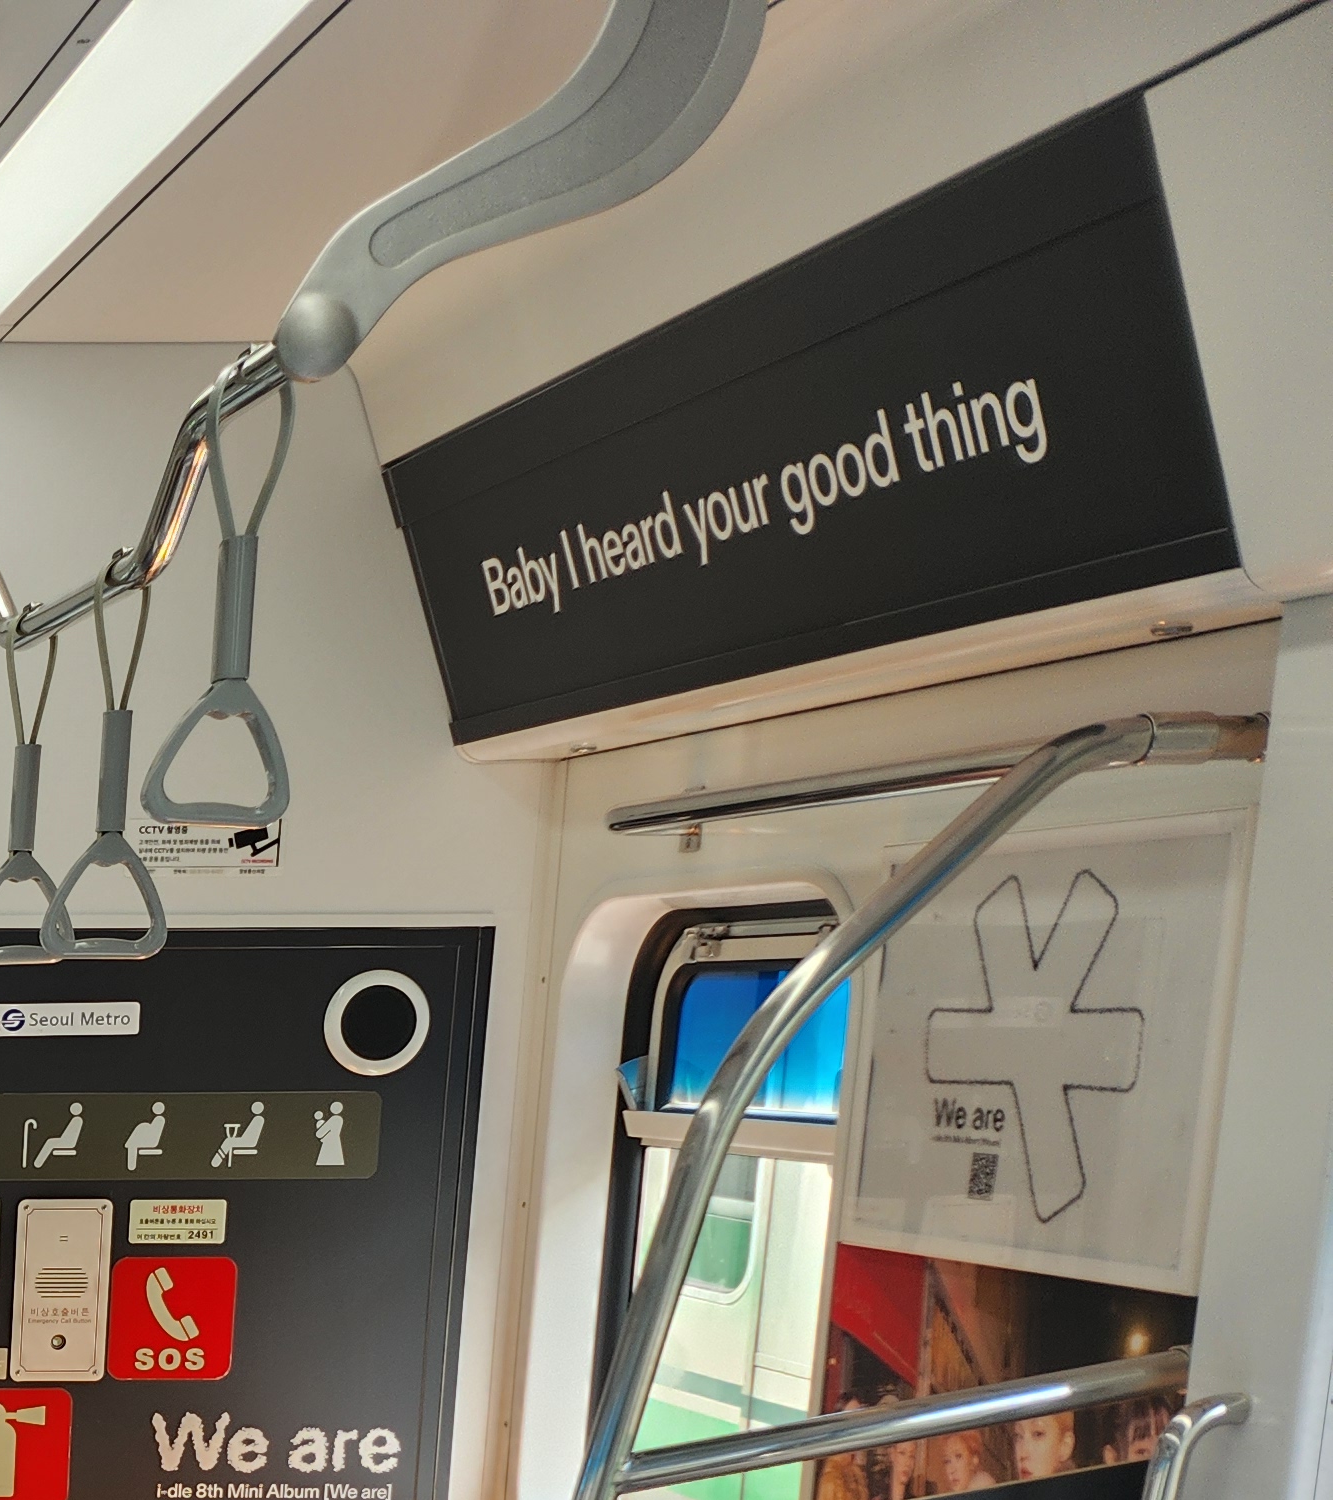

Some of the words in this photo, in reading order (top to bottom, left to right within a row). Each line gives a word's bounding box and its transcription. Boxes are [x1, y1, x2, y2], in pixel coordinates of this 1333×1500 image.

[482, 547, 559, 615] Baby
[561, 530, 579, 588] I
[578, 491, 682, 583] heard
[683, 475, 768, 565] your
[781, 409, 899, 534] good
[904, 379, 1047, 472] thing
[138, 825, 164, 834] CCTV
[28, 1012, 74, 1027] Seoul
[80, 1011, 131, 1026] Metro
[934, 1097, 967, 1130] We
[973, 1107, 1006, 1132] are
[152, 1204, 204, 1215] 비상통화장치
[187, 1230, 214, 1240] 2491
[30, 1307, 90, 1317] 비상호출버튼
[134, 1348, 205, 1371] SOS
[151, 1411, 269, 1474] We
[288, 1426, 401, 1474] are
[156, 1483, 192, 1499] i-dle
[195, 1483, 223, 1499] 8th
[227, 1483, 263, 1499] Mini
[266, 1483, 320, 1499] Album
[323, 1483, 358, 1500] [We
[360, 1483, 392, 1500] are]
